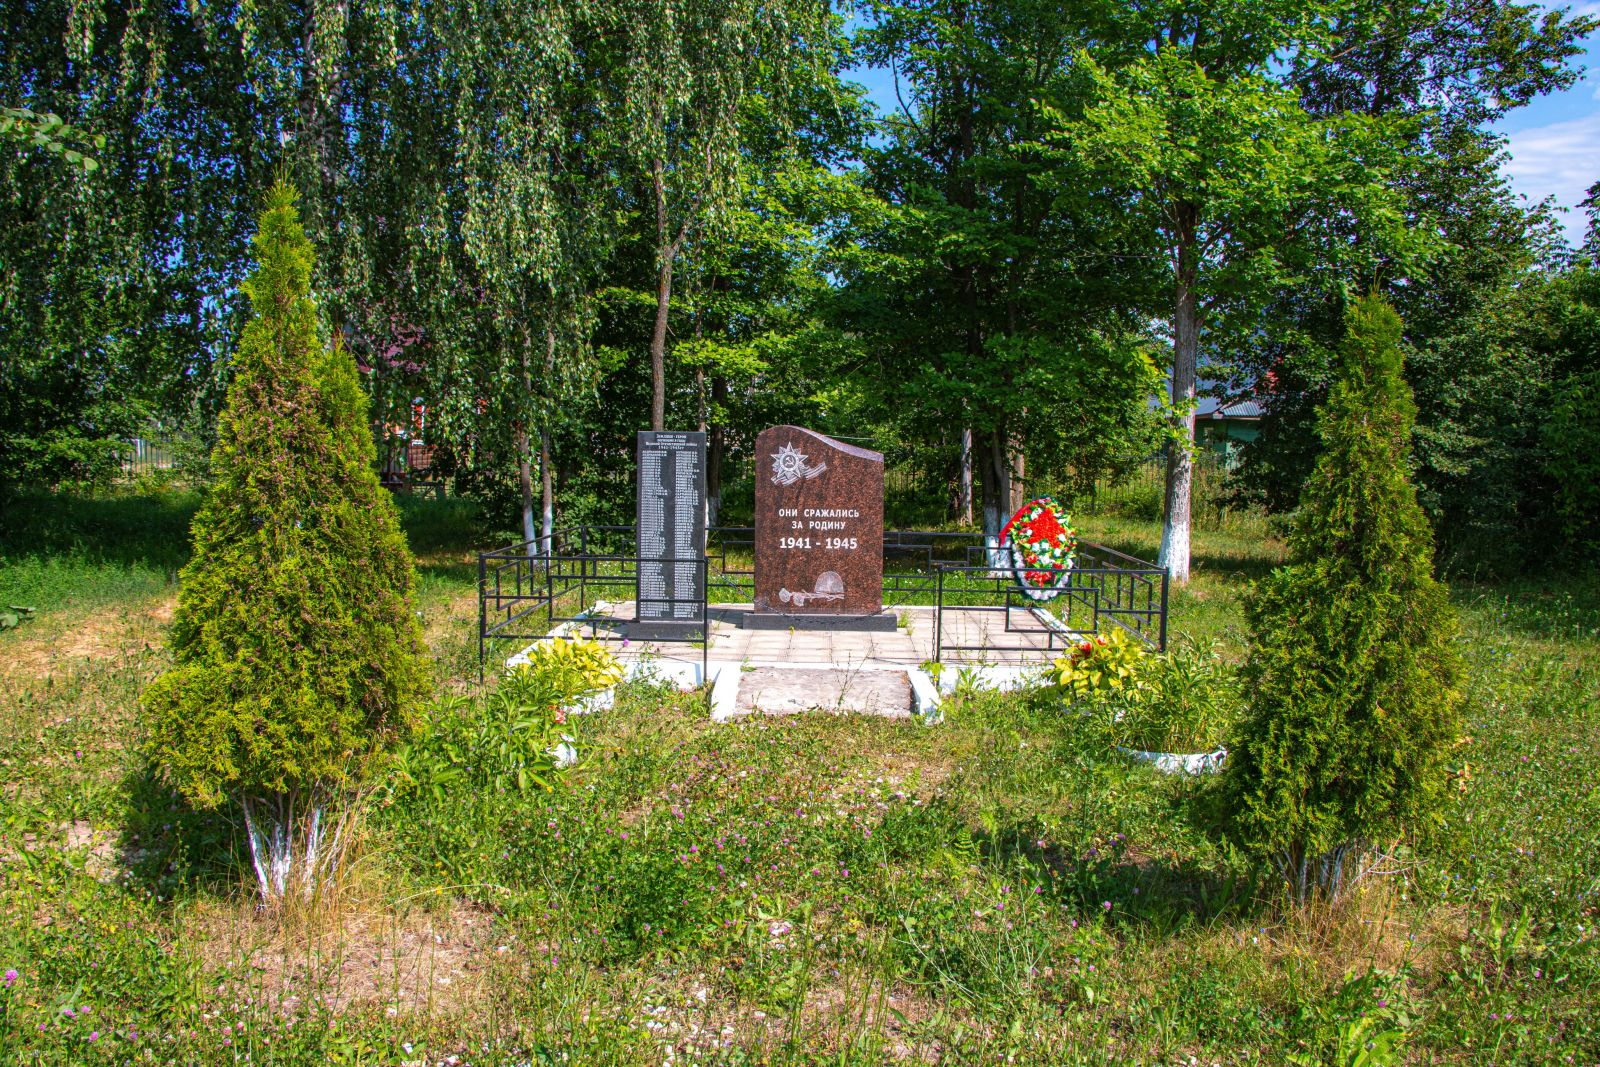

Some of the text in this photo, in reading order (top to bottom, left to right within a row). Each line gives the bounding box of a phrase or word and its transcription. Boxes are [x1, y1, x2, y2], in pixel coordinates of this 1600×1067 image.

[779, 509, 860, 518] ОНИ СРАЖАЛИСЬ
[791, 521, 846, 530] ЗА РОДИНУ
[779, 537, 811, 549] 1941
[825, 537, 858, 549] 1945
